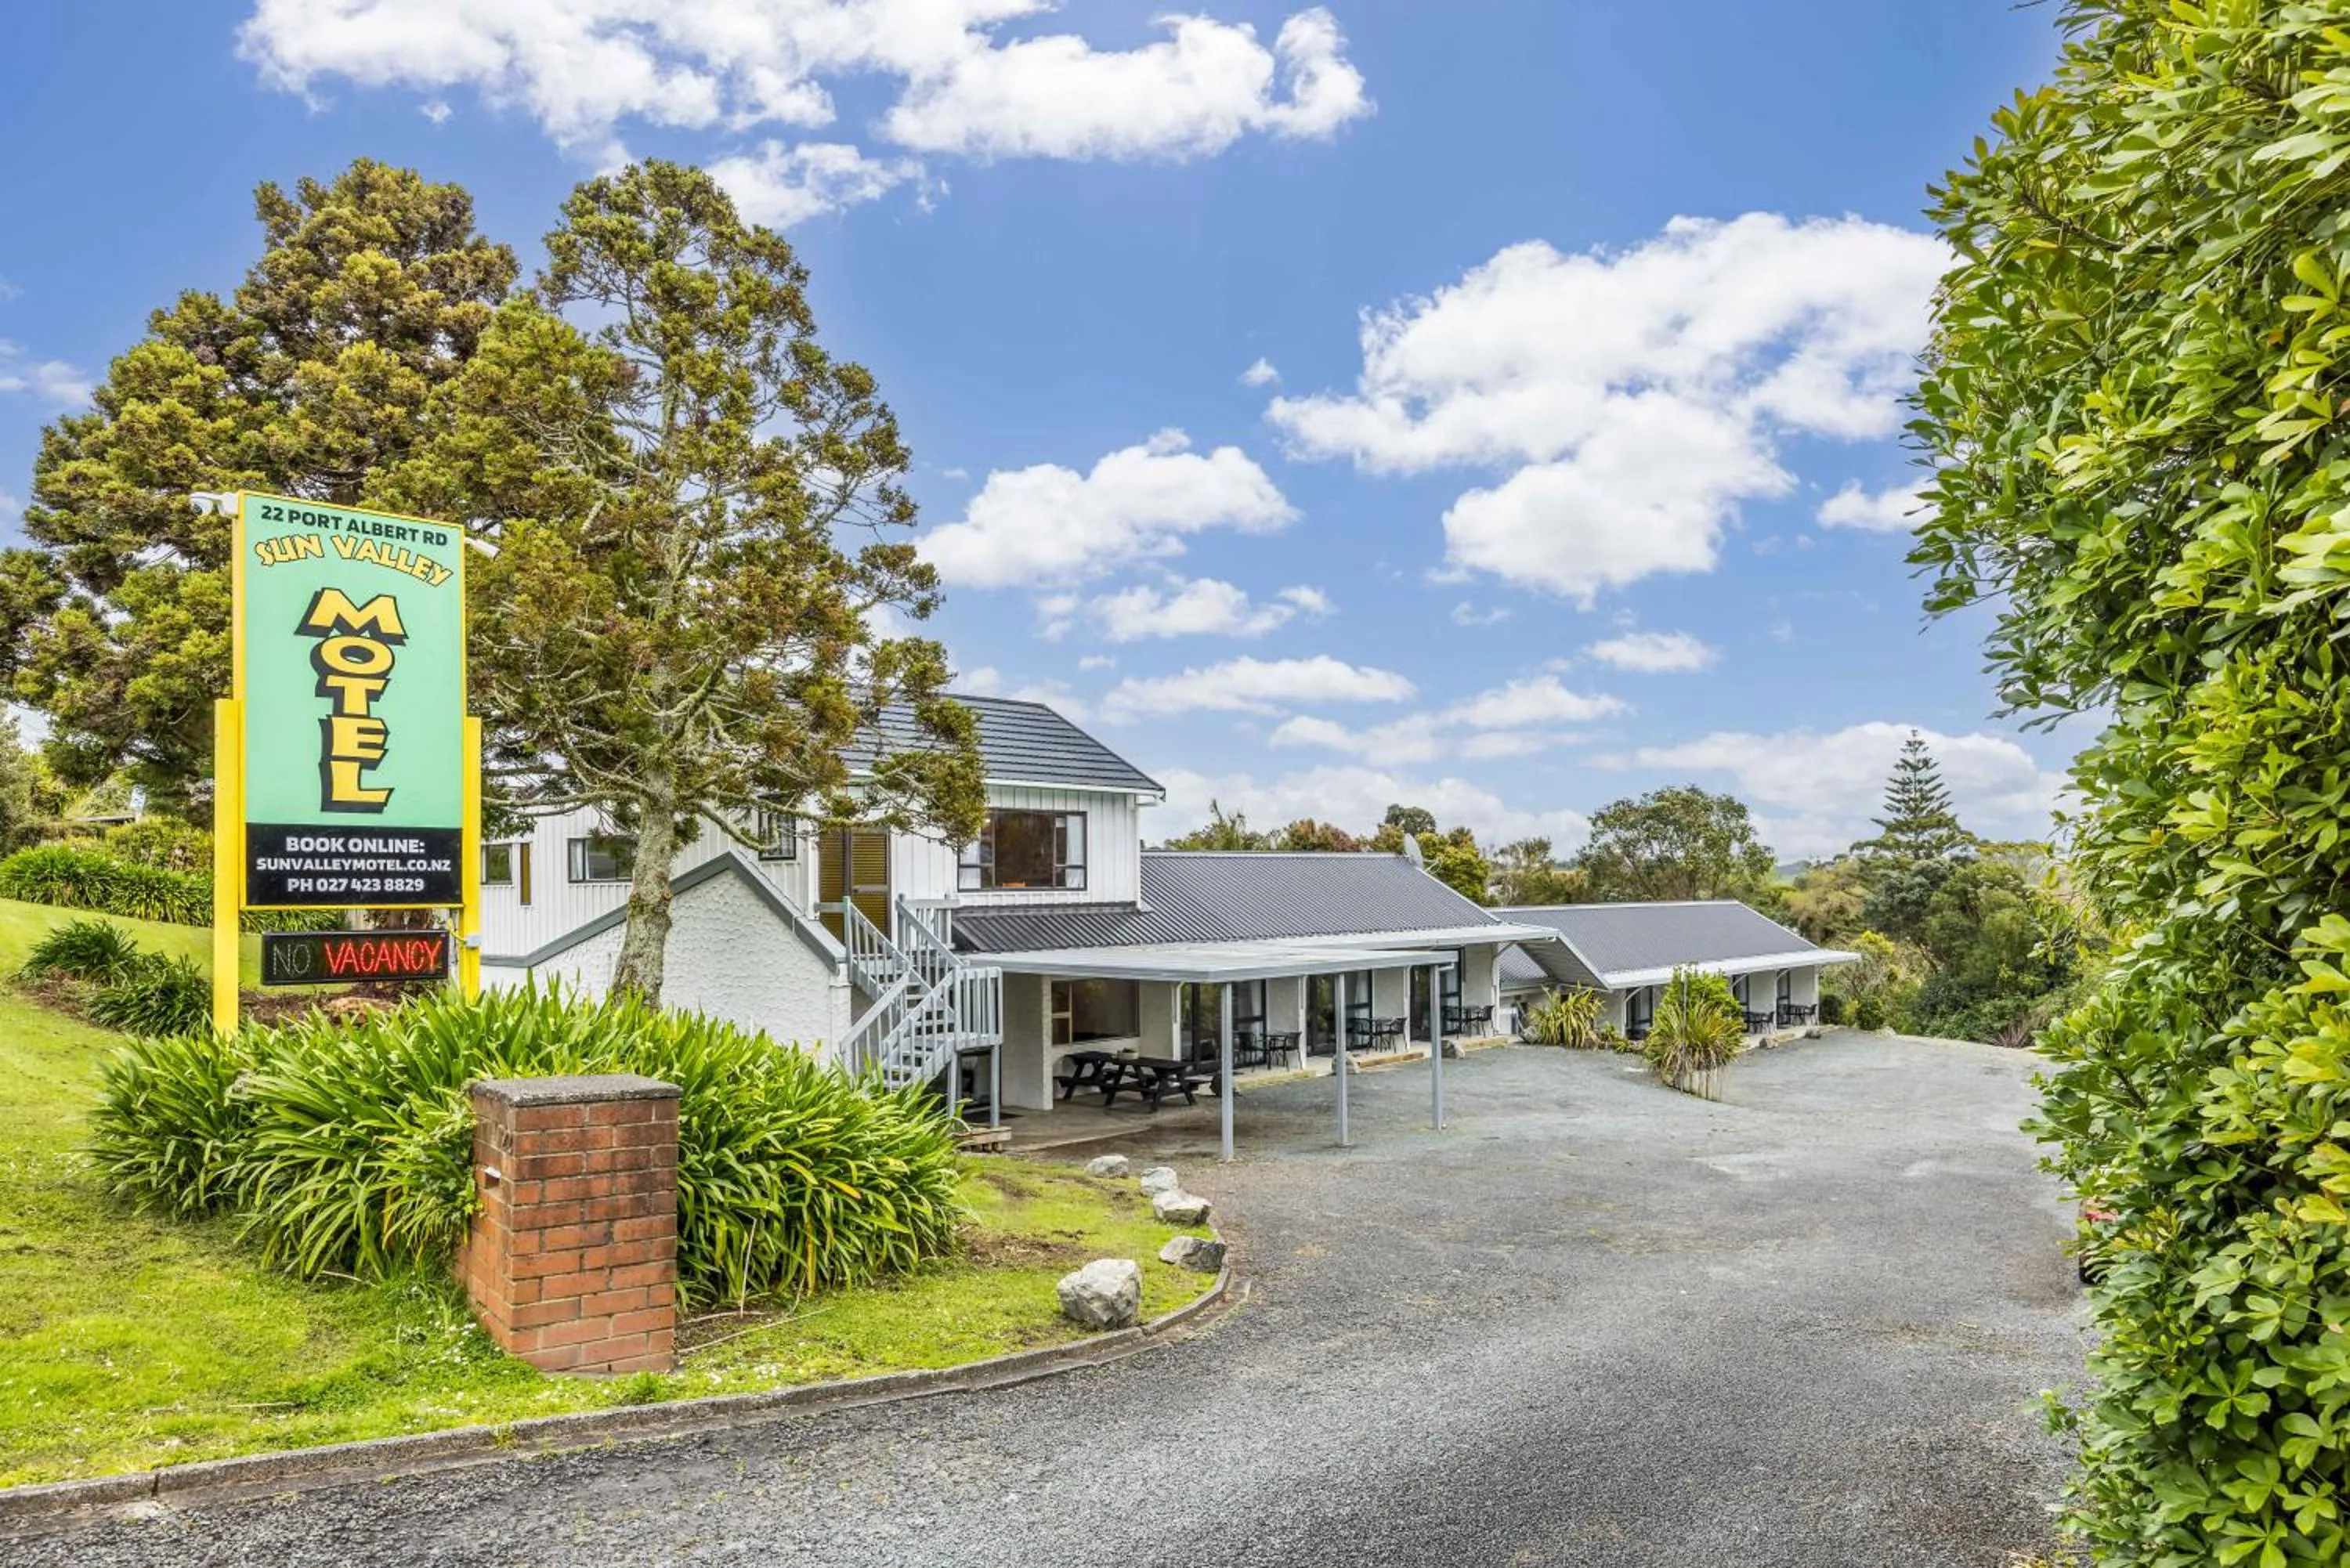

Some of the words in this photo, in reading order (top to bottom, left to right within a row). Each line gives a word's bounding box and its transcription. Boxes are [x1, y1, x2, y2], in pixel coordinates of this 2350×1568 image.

[261, 505, 284, 522] 22
[288, 509, 343, 530] PORT
[346, 518, 419, 541] ALBERT
[422, 530, 448, 547] RD
[254, 533, 325, 567] SUN
[331, 534, 454, 587] VALLEY
[294, 587, 410, 814] MOTEL
[285, 836, 345, 854] BOOK
[348, 836, 425, 854] ONLINE:
[256, 858, 451, 872] SUNVALLEYMOTEL.CO.NZ
[287, 878, 313, 892] PH
[316, 878, 349, 892] 027
[350, 878, 381, 891] 423
[384, 878, 425, 892] 8829
[273, 943, 311, 975] NO
[324, 939, 443, 975] VACANCY
